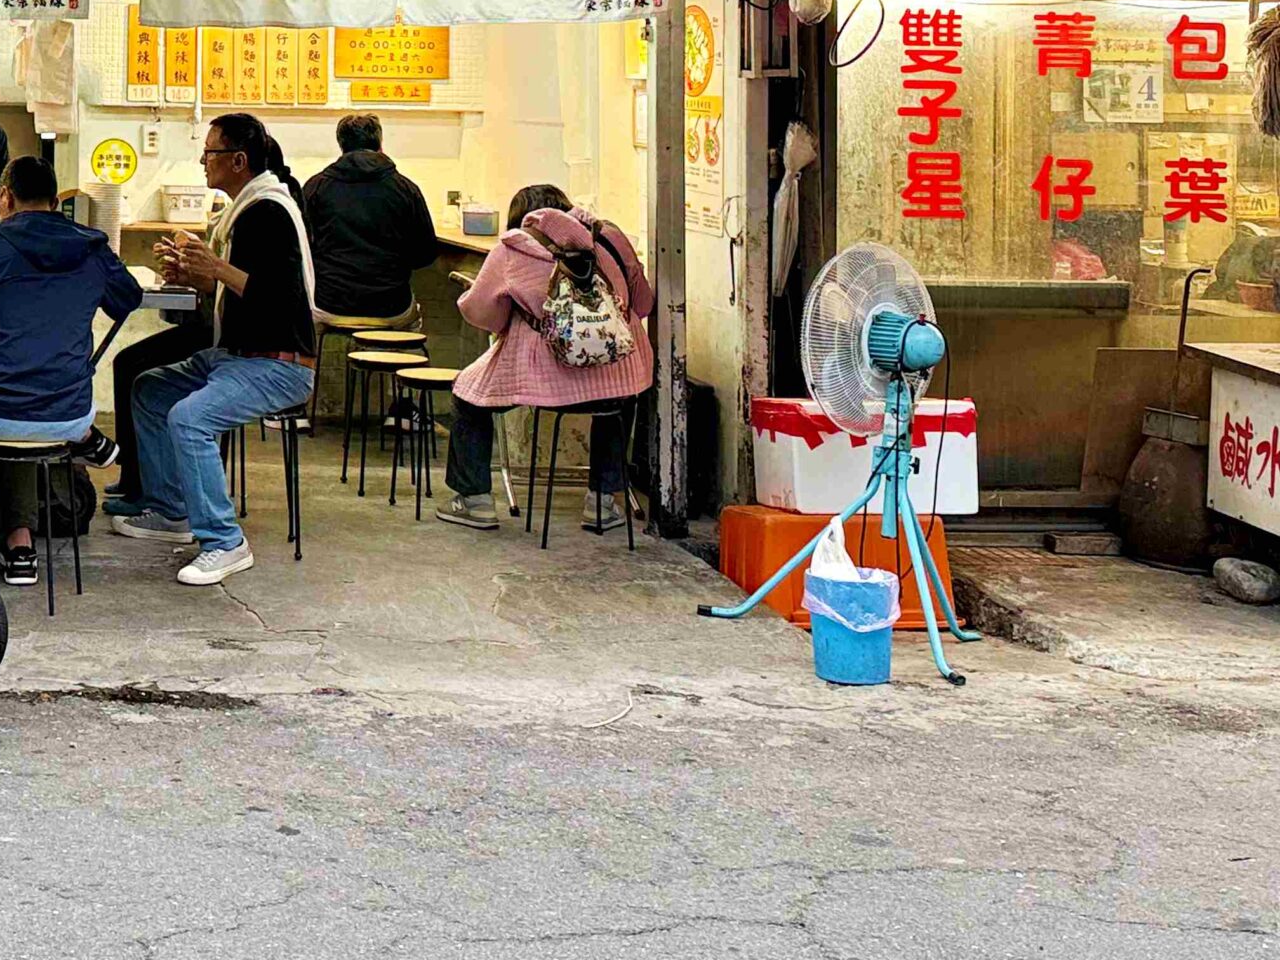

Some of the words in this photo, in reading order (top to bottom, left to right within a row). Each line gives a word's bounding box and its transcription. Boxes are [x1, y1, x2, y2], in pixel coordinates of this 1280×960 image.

[897, 8, 967, 221] 雙子星
[1030, 11, 1097, 223] 菁仔
[1138, 75, 1157, 102] 4
[1163, 14, 1229, 224] 包葉
